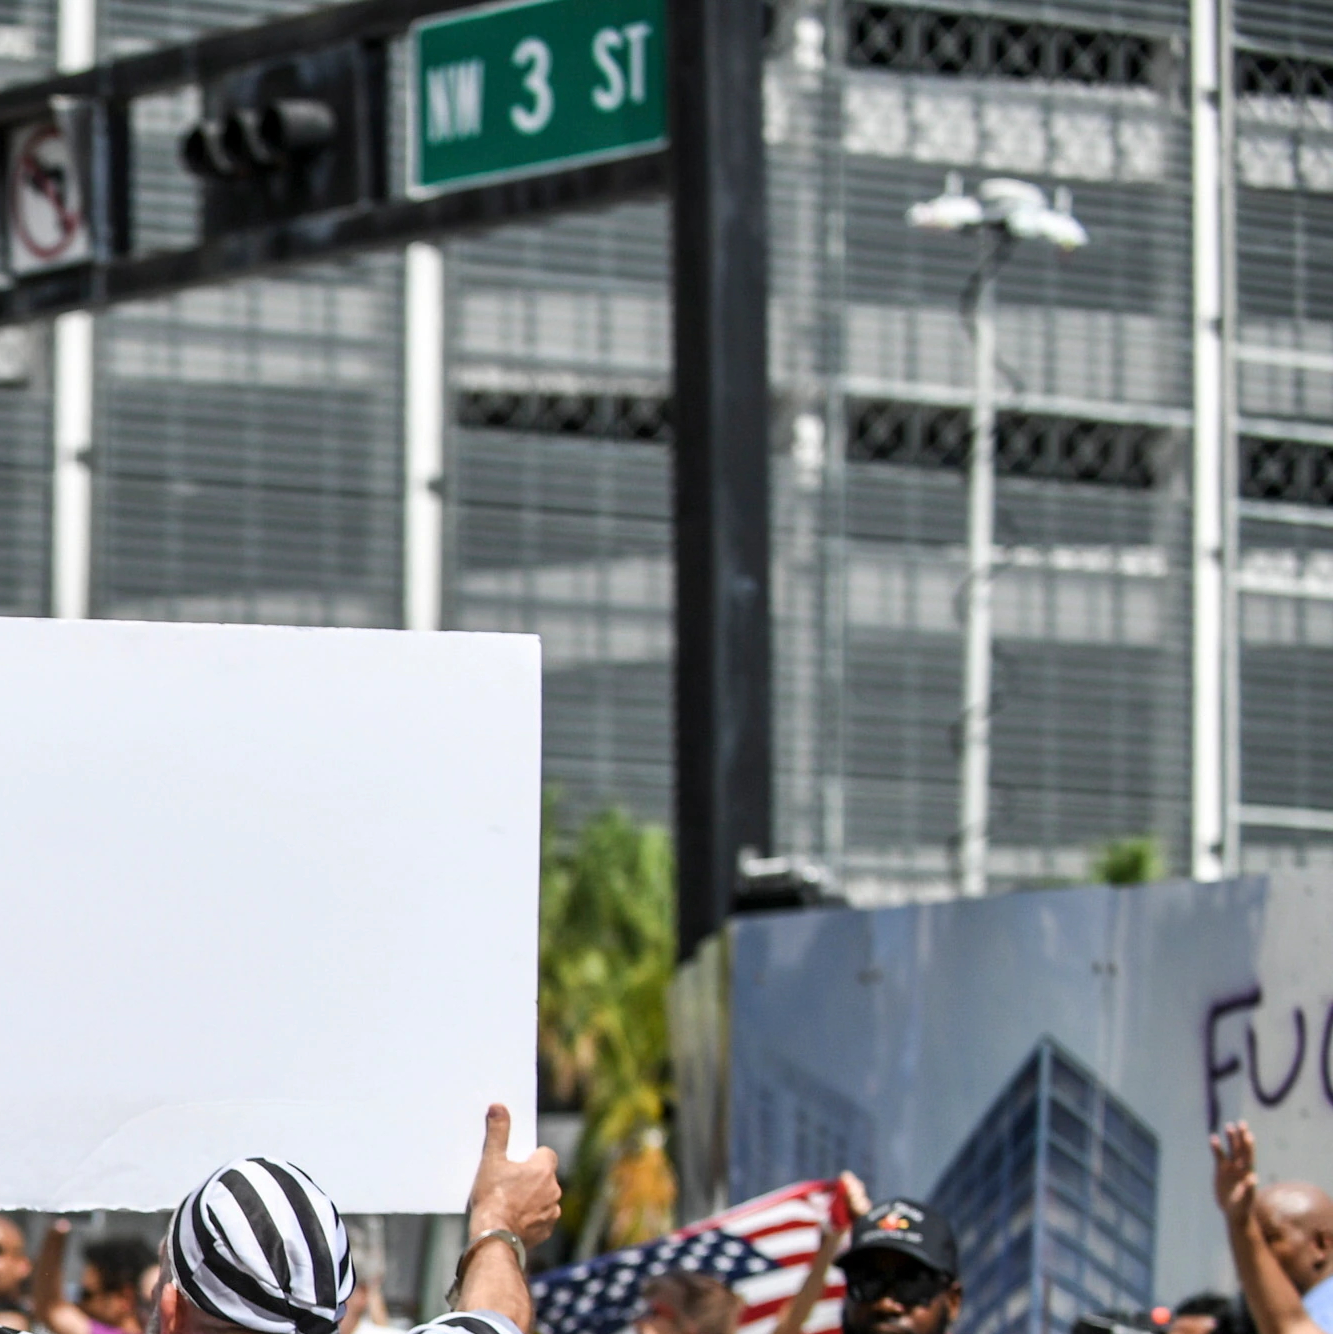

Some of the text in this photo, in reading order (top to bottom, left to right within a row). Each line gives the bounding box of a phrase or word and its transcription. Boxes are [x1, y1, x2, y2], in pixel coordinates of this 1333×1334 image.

[426, 20, 653, 145] NW 3 ST
[1202, 984, 1333, 1136] FU
